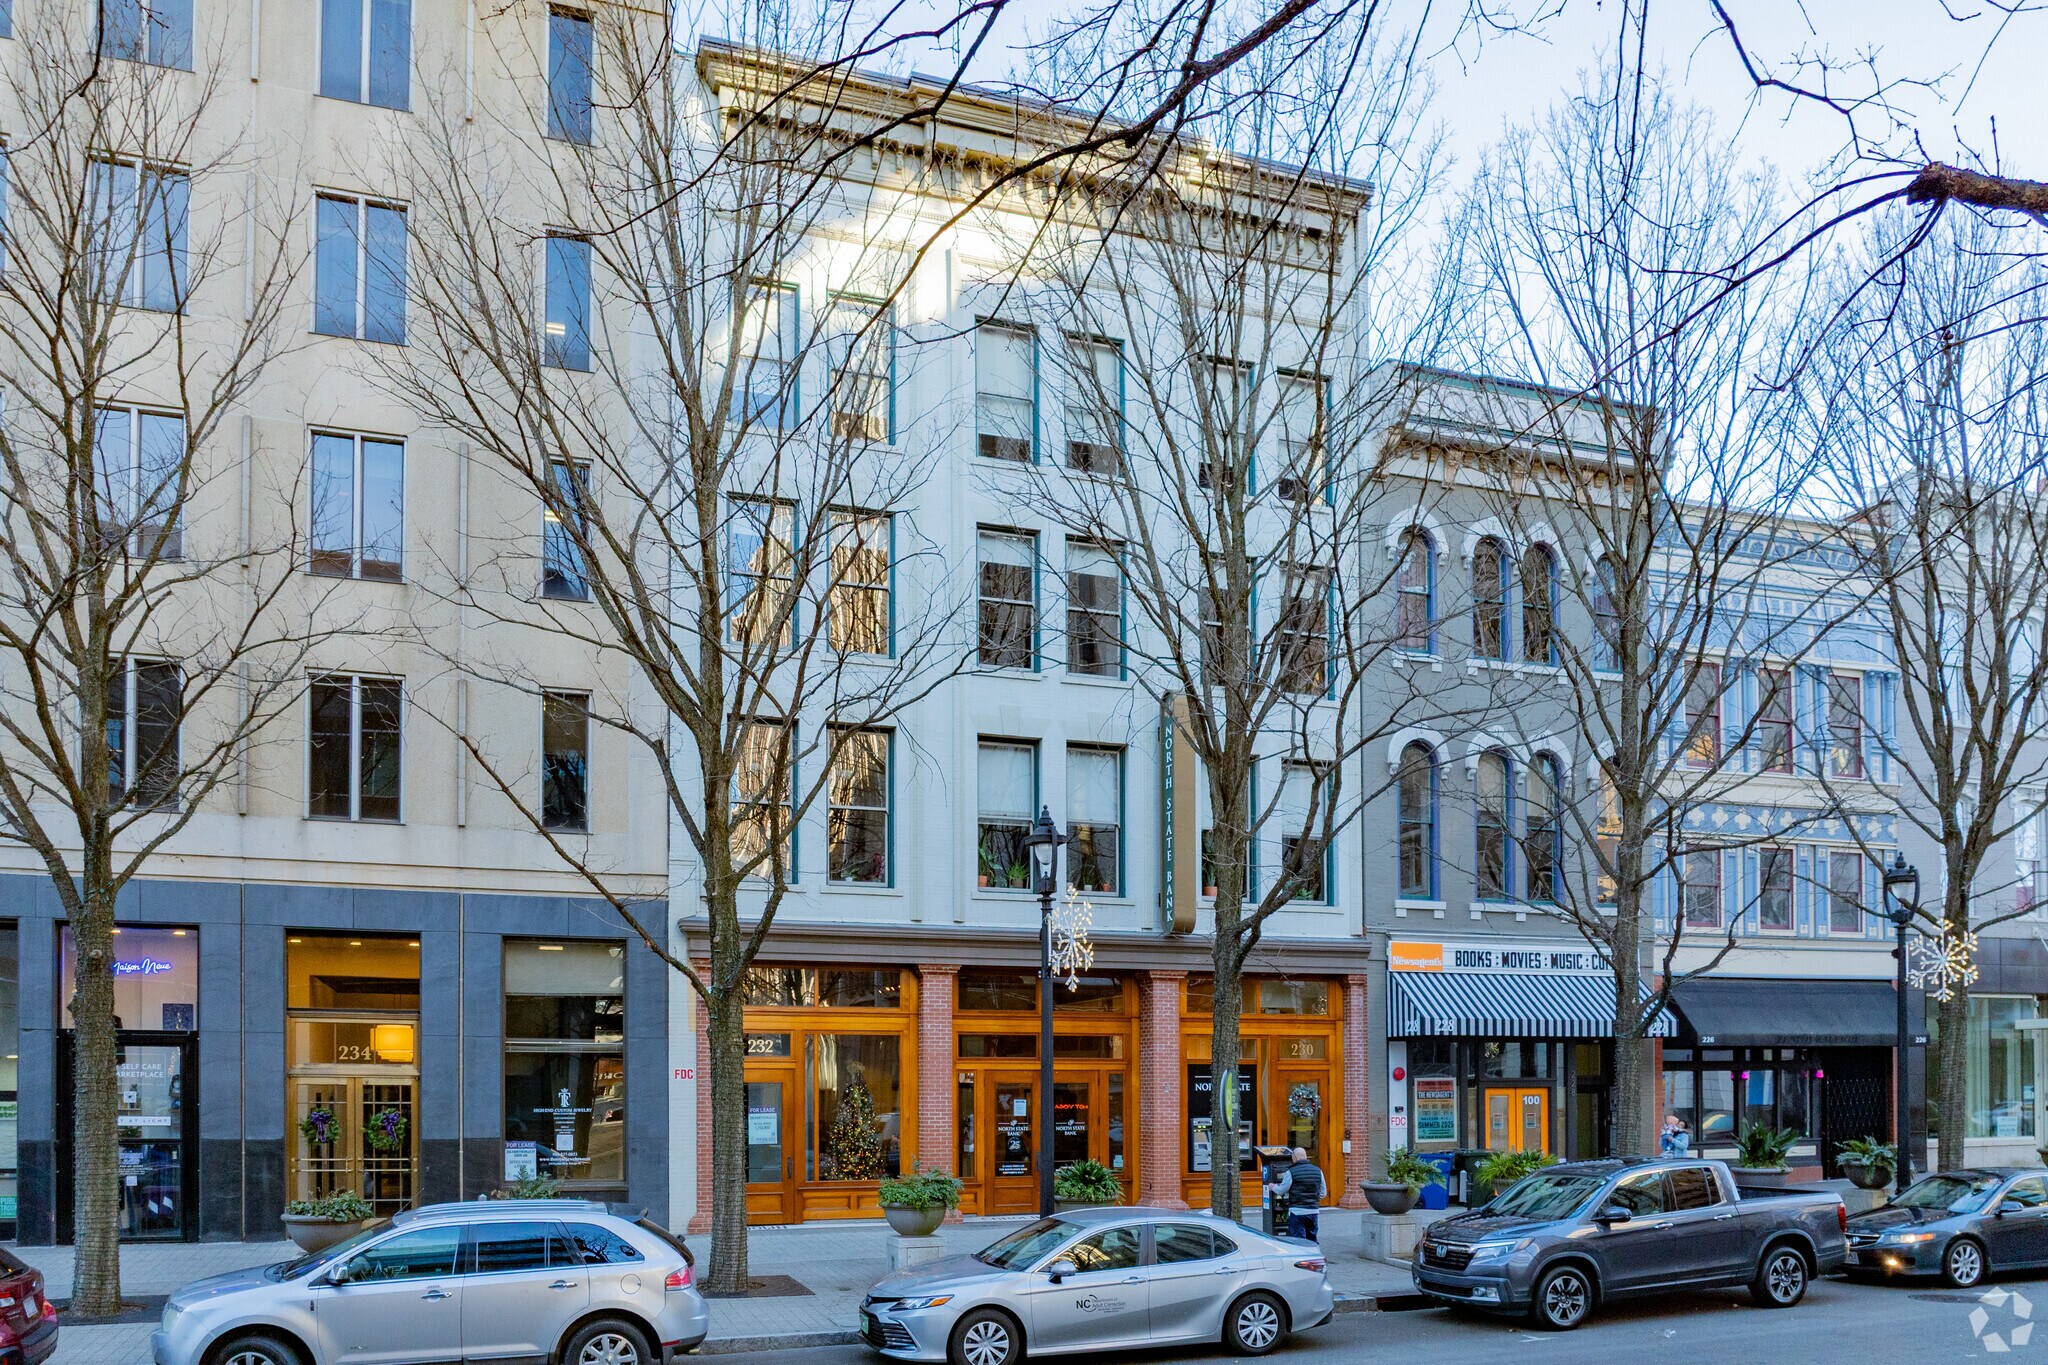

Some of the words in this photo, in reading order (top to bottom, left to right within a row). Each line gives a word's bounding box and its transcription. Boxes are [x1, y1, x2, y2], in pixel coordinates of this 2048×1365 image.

[1164, 724, 1172, 788] NORTH
[1392, 956, 1442, 968] Newsagent's
[1455, 950, 1492, 968] BOOKS
[1502, 952, 1542, 968] MOVIES
[1550, 953, 1583, 970] MUSIC
[1405, 1020, 1418, 1032] 228
[1434, 1020, 1454, 1032] 228
[1651, 1022, 1669, 1034] 228
[748, 1040, 774, 1053] 232
[1291, 1044, 1314, 1056] 230
[338, 1046, 372, 1060] 234
[674, 1069, 694, 1080] FDC
[1523, 1096, 1540, 1105] 100
[1391, 1116, 1406, 1126] FDC
[1010, 1140, 1020, 1150] 25
[1076, 1300, 1090, 1309] NC
